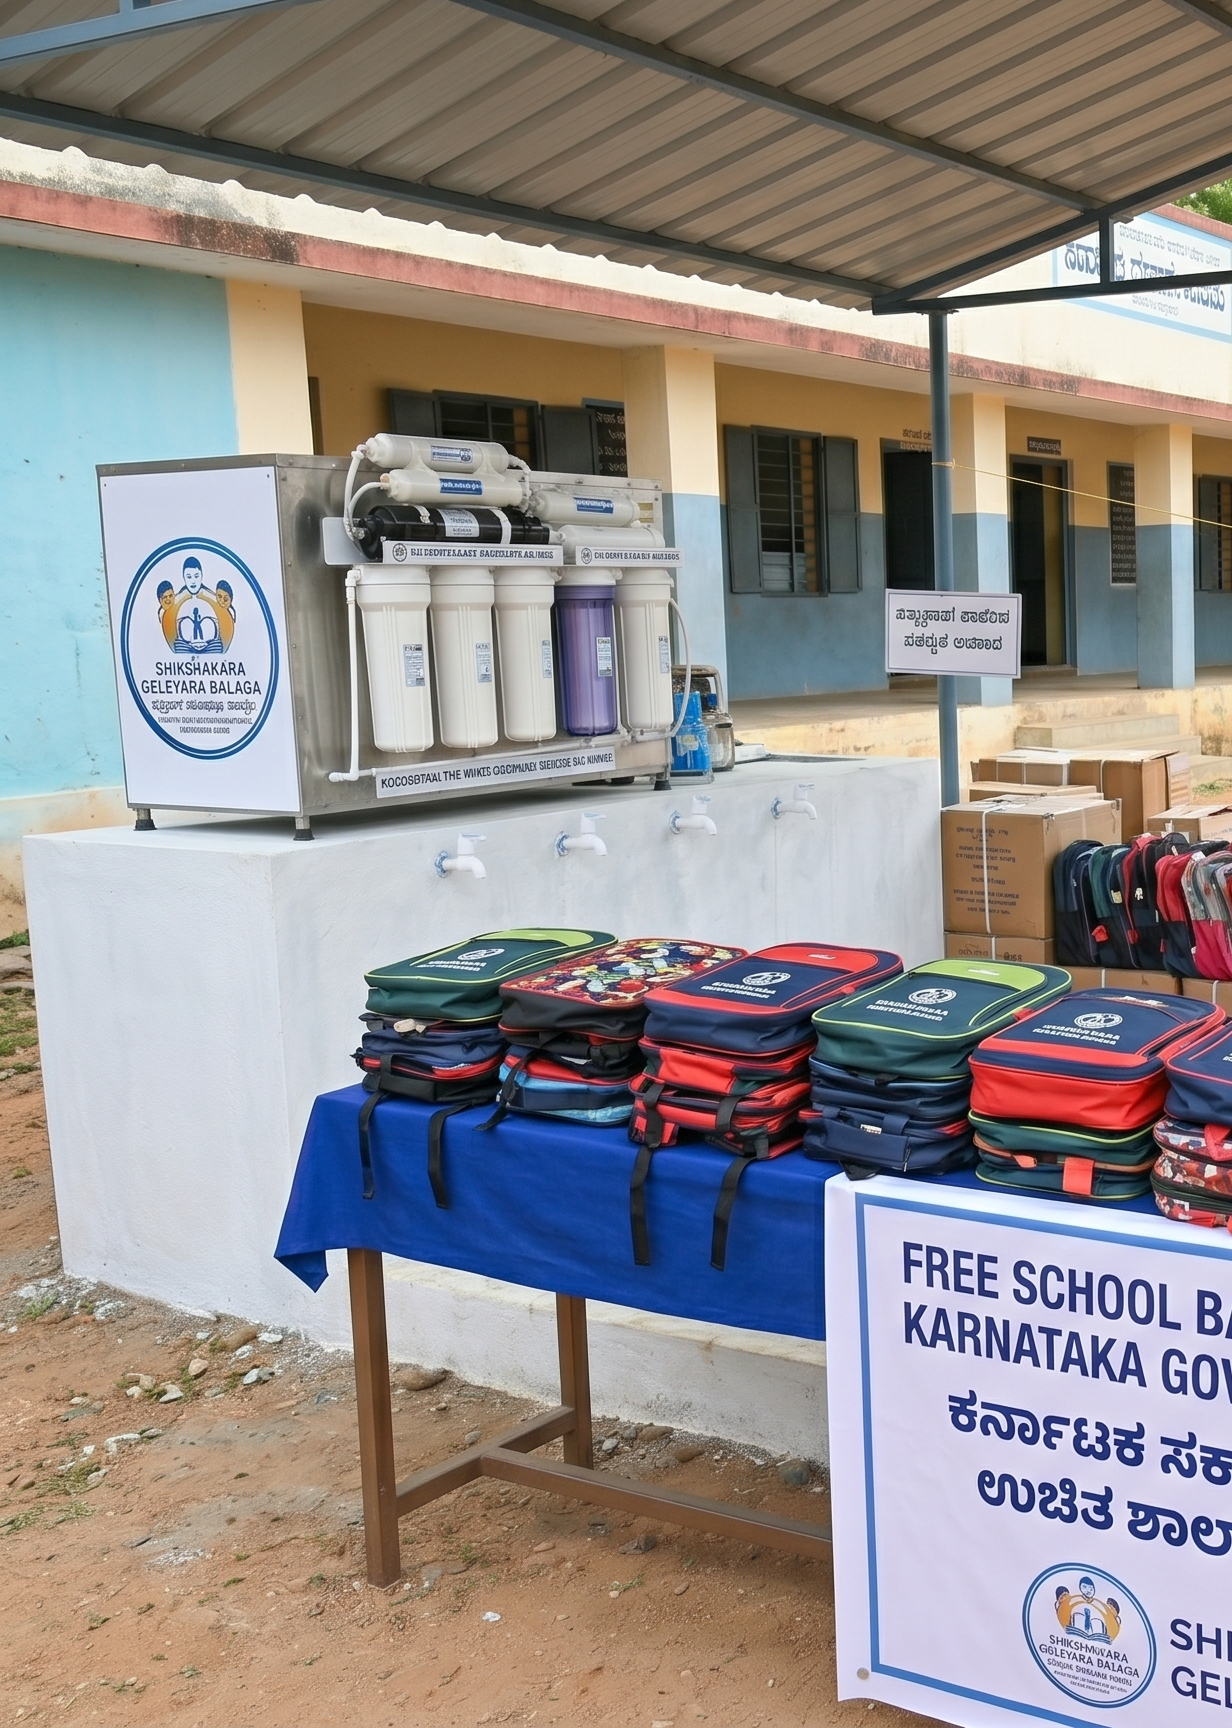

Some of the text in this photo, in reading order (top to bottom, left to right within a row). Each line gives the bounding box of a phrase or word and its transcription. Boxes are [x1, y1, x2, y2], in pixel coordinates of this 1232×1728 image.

[141, 679, 262, 695] GELEYARA BALAGA
[155, 661, 246, 676] SHIKSHAKARA
[443, 769, 461, 781] THE
[902, 1241, 999, 1300] FREE
[1012, 1259, 1181, 1331] SCHOOL
[903, 1301, 1147, 1388] KARNATAKA
[949, 1389, 1146, 1467] ಕರ್ನಾಟಕ
[977, 1469, 1114, 1530] ಉಚಿತ
